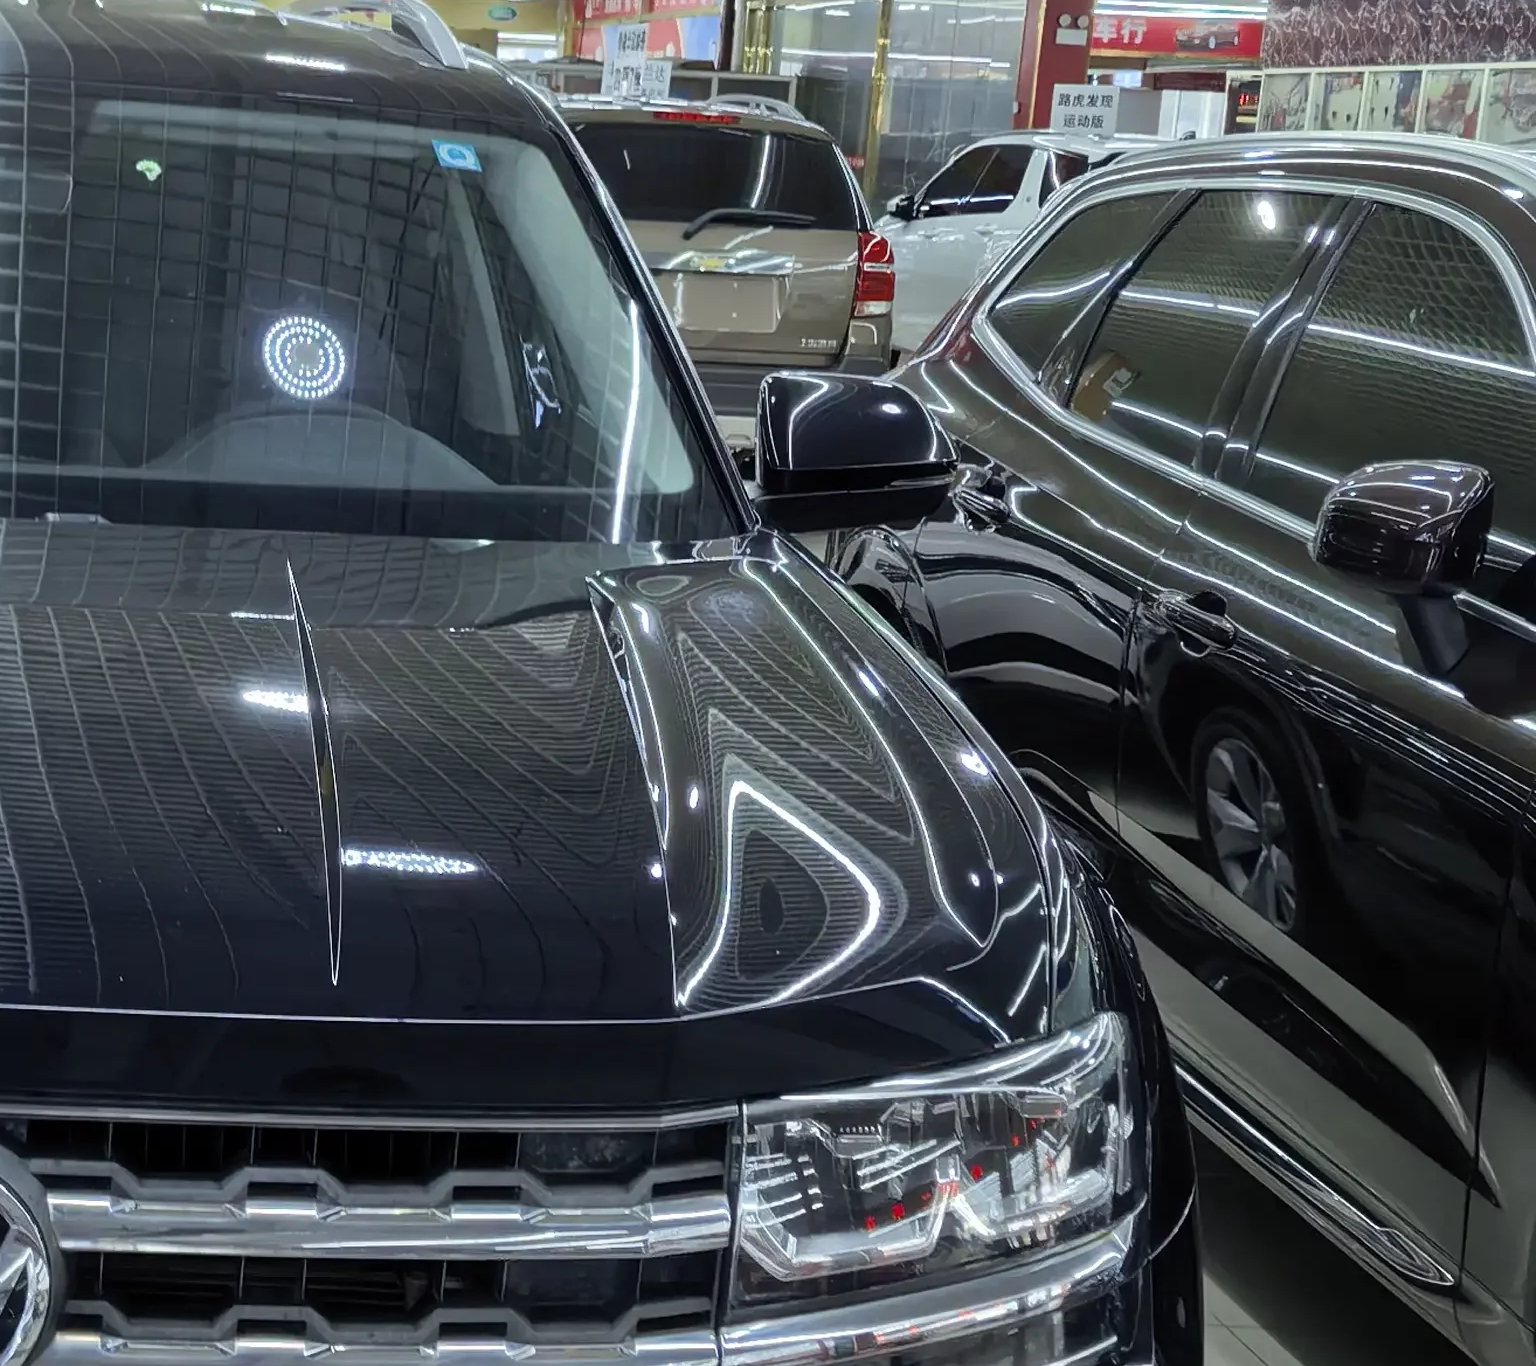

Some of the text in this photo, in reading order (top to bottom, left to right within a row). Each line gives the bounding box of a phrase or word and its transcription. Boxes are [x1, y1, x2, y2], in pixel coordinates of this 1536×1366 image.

[1093, 16, 1147, 44] 车行
[1058, 93, 1114, 109] 路虎发现
[1063, 114, 1104, 129] 运动版
